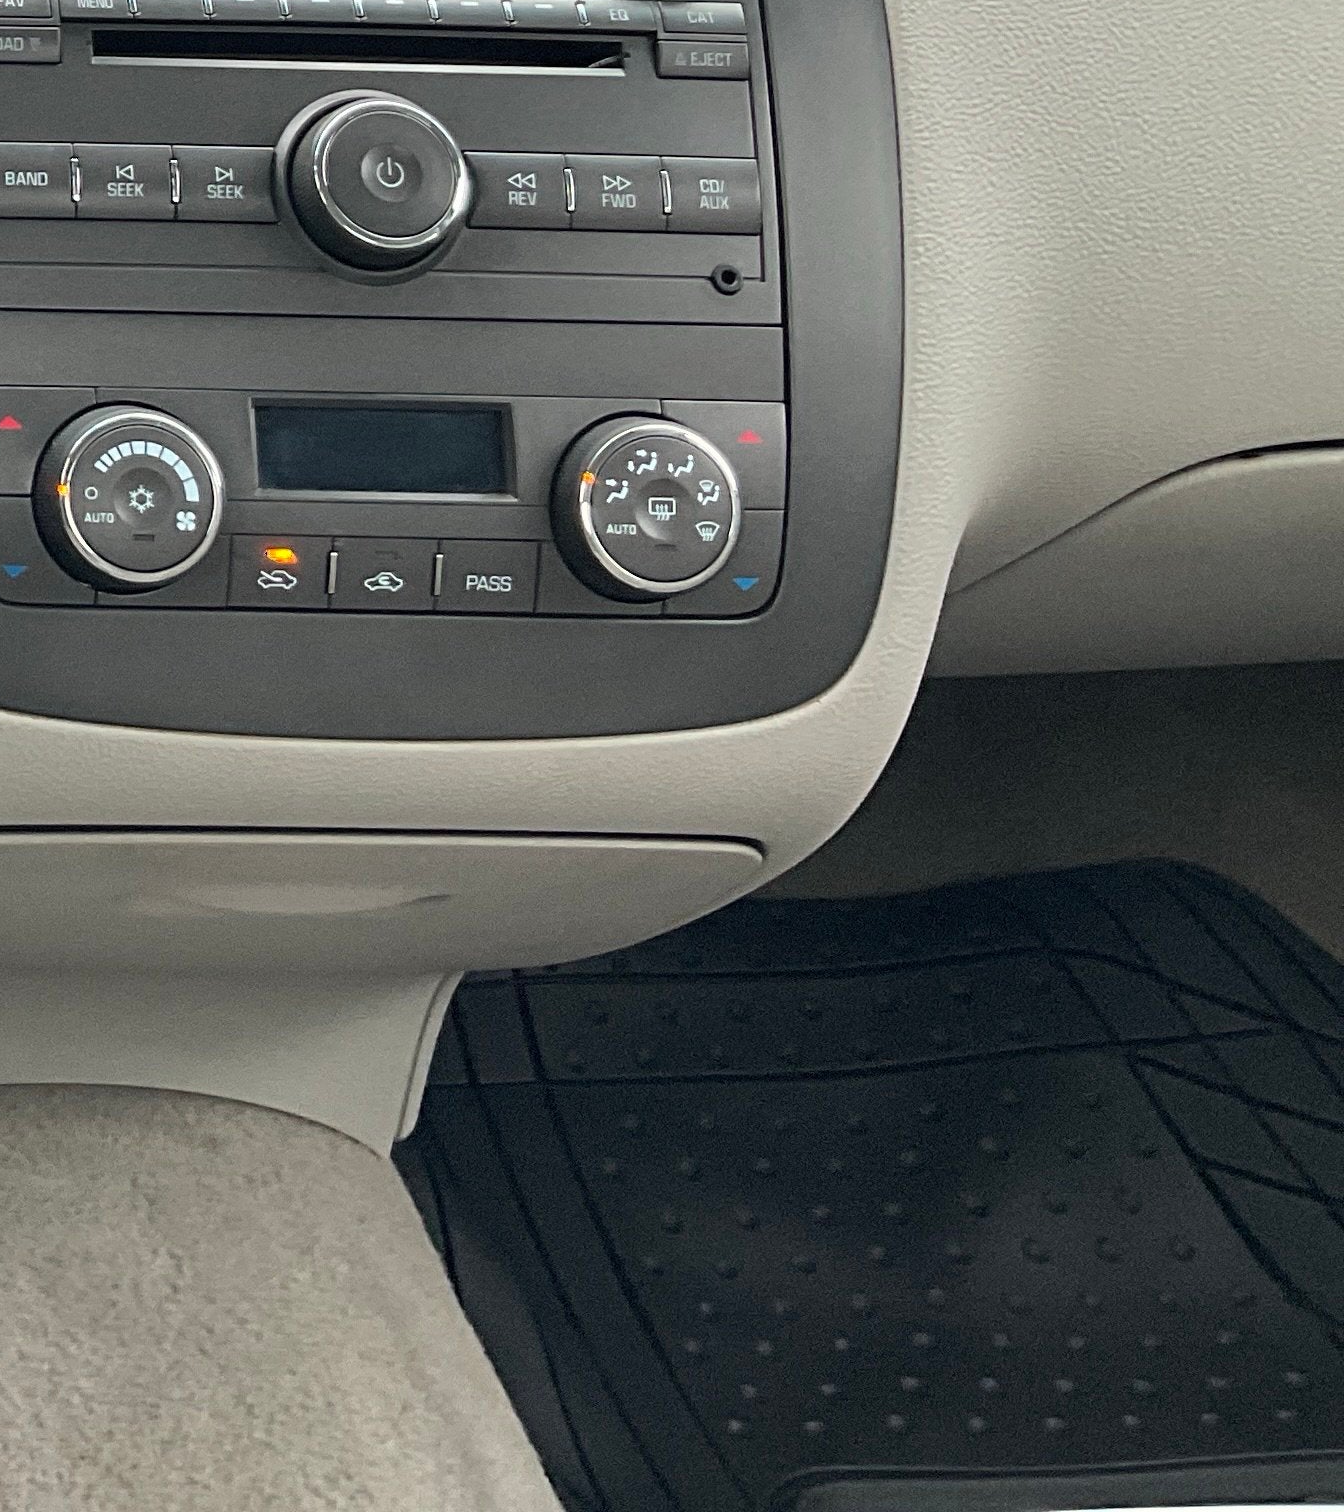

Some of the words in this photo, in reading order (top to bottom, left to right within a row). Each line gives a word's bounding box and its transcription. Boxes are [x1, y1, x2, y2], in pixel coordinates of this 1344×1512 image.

[609, 8, 629, 21] EQ
[687, 11, 713, 24] CAT
[690, 52, 733, 67] EJECT
[4, 171, 49, 187] BAND
[699, 179, 724, 193] CD/
[107, 182, 144, 198] SEEK
[207, 185, 243, 200] SEEK
[508, 191, 536, 206] REV
[601, 193, 637, 209] FWD
[699, 195, 730, 210] AUX
[84, 512, 115, 524] AUTO
[606, 522, 637, 536] AUTO
[465, 574, 512, 592] PASS
